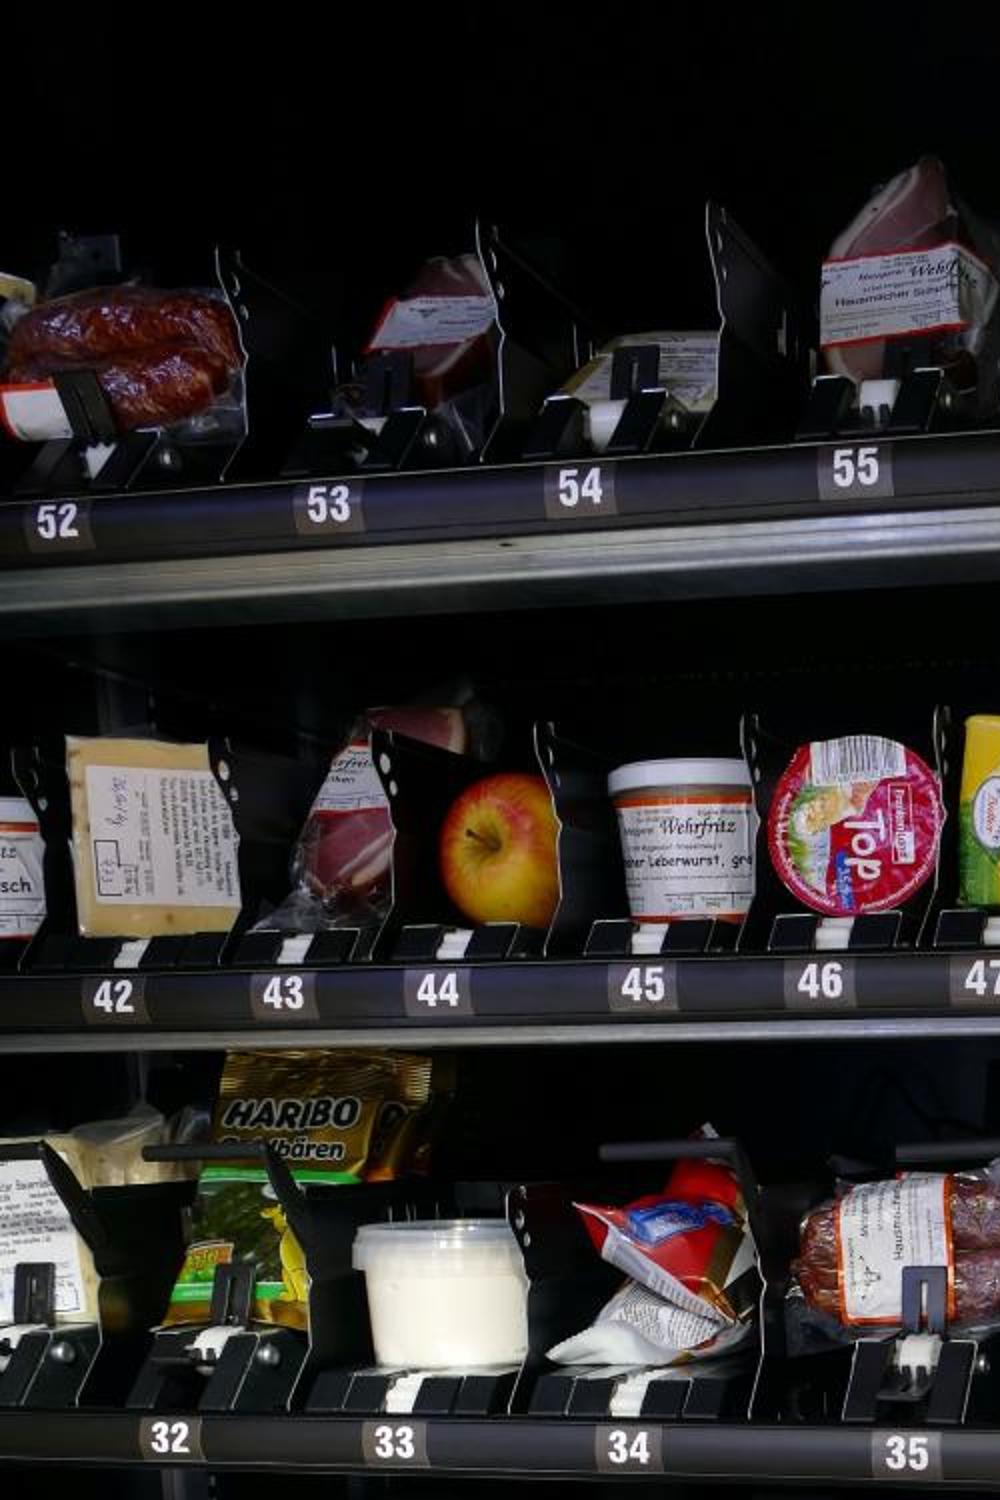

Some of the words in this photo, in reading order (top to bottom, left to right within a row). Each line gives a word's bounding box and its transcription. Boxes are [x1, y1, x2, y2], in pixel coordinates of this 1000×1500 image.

[834, 448, 878, 487] 55
[308, 486, 350, 522] 53
[559, 468, 602, 506] 54
[37, 504, 78, 539] 52
[660, 817, 737, 838] Wehrfritz
[842, 808, 885, 880] Top
[94, 980, 134, 1013] 42
[263, 976, 304, 1009] 43
[417, 972, 459, 1007] 44
[621, 966, 664, 1001] 45
[798, 962, 842, 998] 46
[221, 1096, 362, 1130] HARIBO
[151, 1422, 190, 1453] 32
[374, 1425, 415, 1458] 33
[608, 1429, 650, 1464] 34
[885, 1436, 929, 1471] 35
